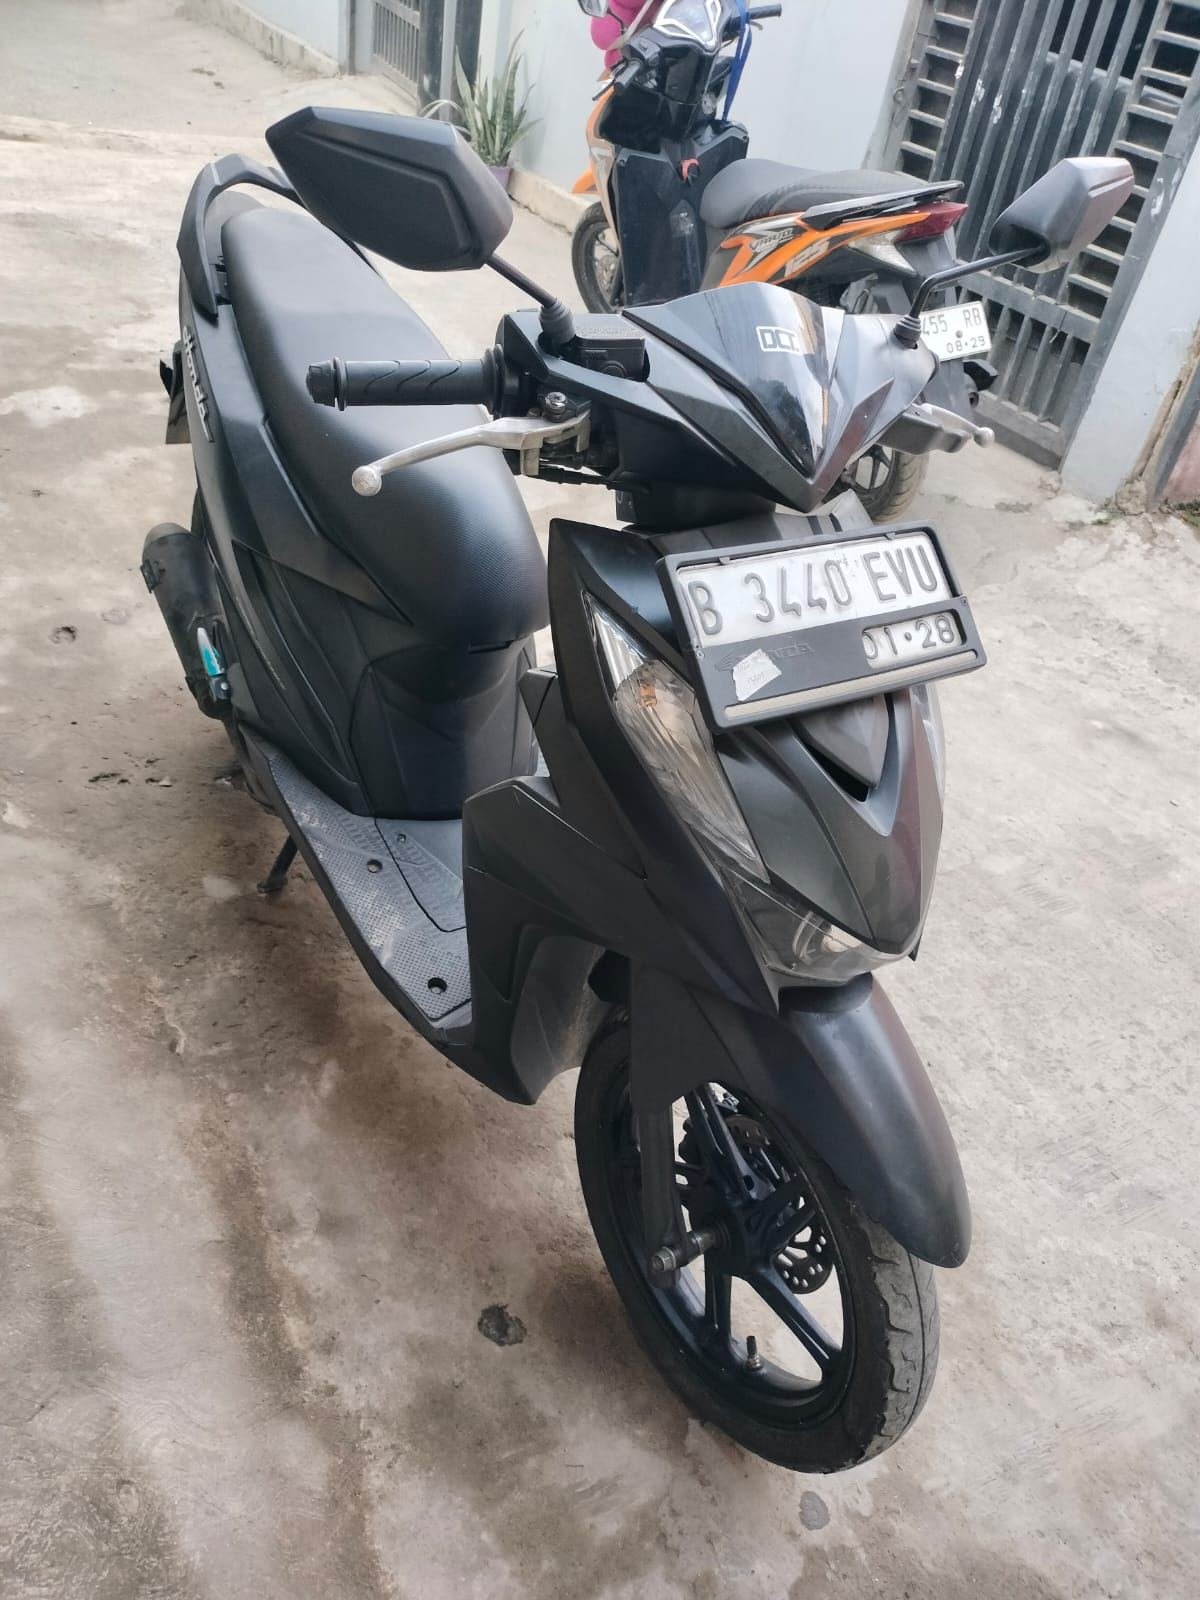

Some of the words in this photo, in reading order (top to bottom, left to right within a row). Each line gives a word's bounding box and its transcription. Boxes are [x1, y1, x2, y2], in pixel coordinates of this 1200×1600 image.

[963, 307, 982, 328] RB
[687, 580, 723, 636] B
[744, 559, 852, 623] 3440
[862, 544, 938, 602] EVU
